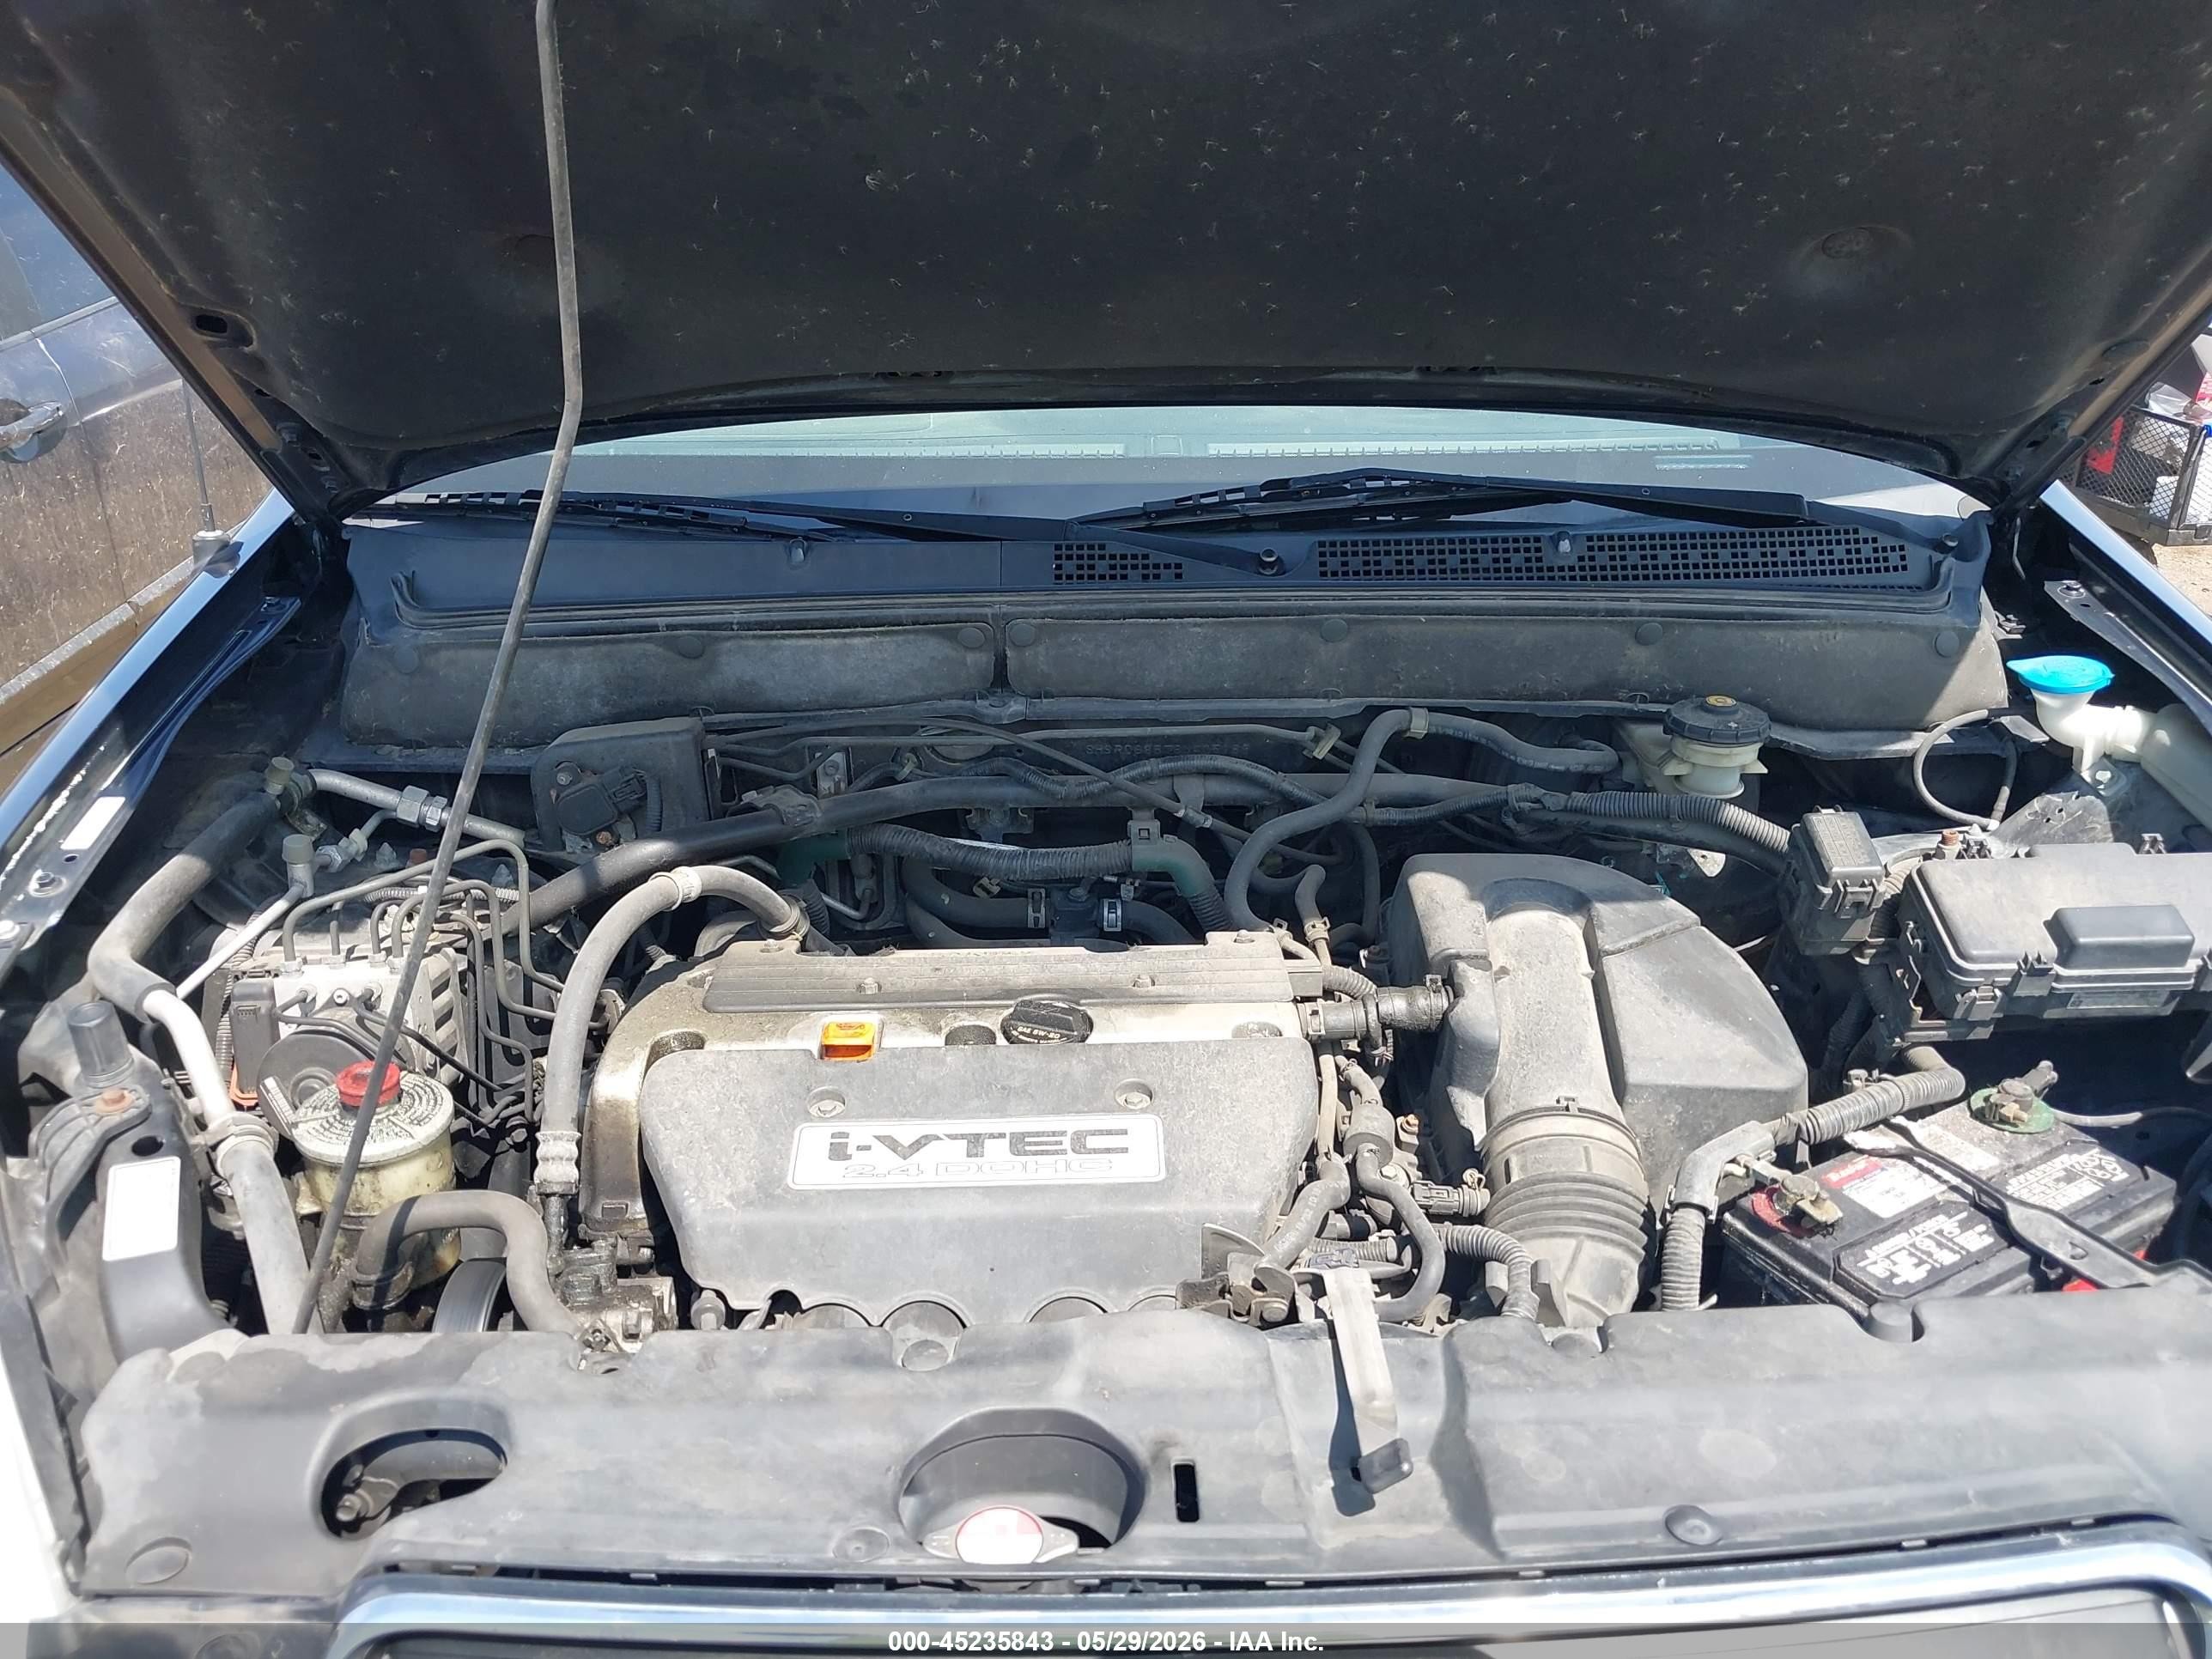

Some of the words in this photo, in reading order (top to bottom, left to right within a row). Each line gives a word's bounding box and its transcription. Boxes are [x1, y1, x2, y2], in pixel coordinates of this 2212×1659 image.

[1033, 1029, 1060, 1038] 5W-20
[828, 1128, 1129, 1162] i-VTEC
[842, 1163, 923, 1179] 2.4
[935, 1158, 1113, 1176] DOHC
